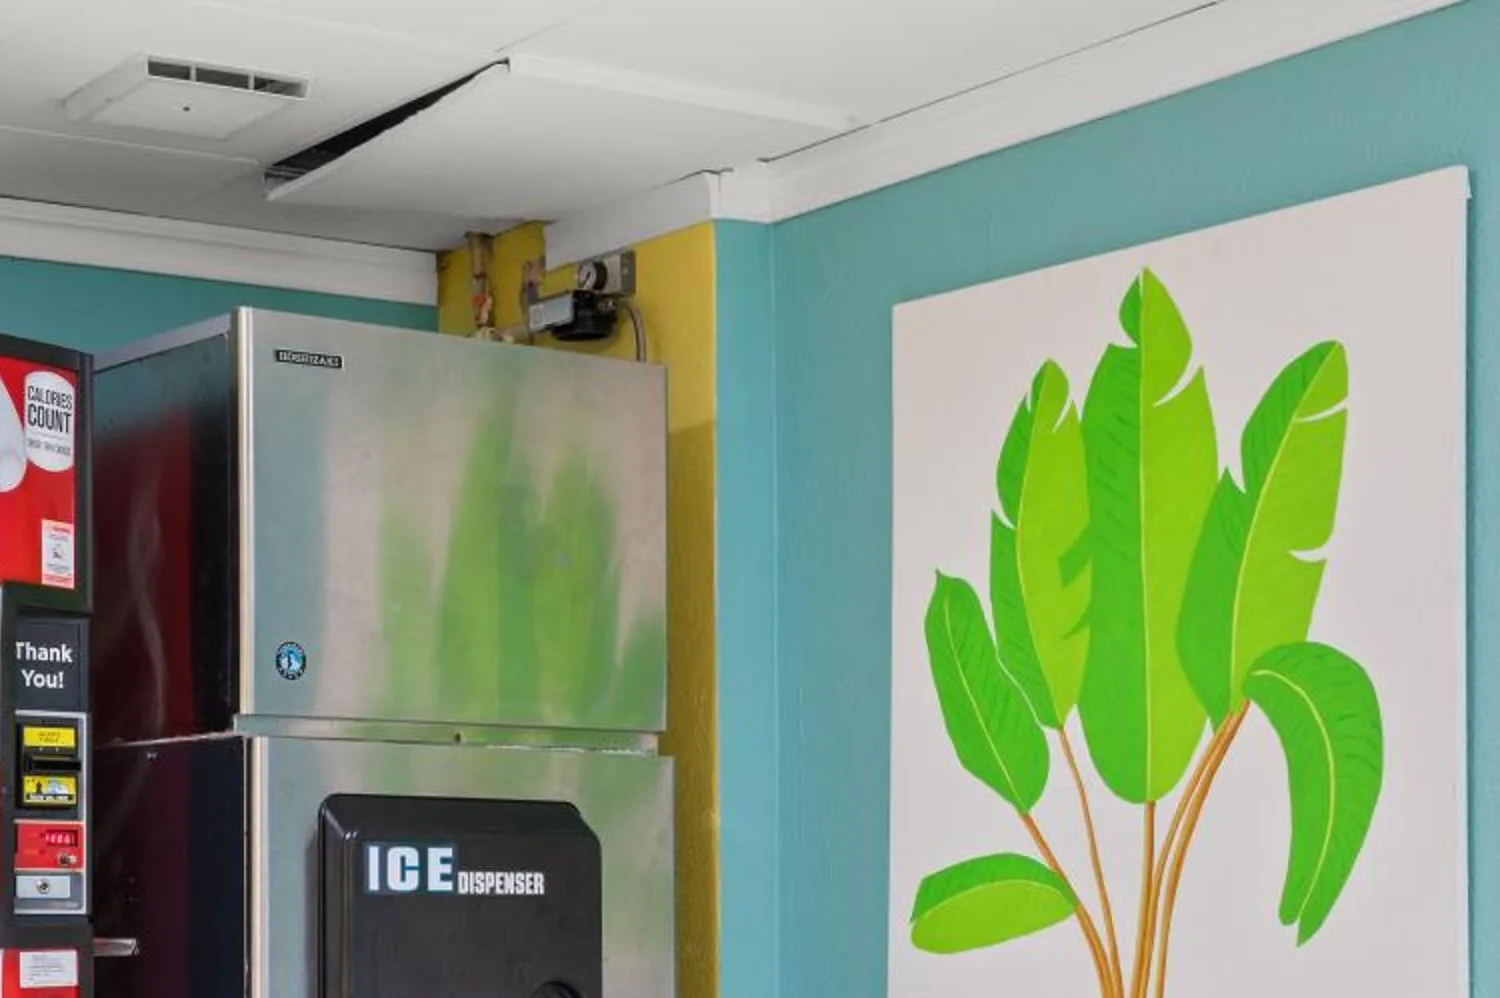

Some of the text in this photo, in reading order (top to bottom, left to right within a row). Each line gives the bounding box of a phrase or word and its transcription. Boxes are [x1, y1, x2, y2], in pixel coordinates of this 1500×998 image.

[27, 403, 73, 434] COUNT
[15, 641, 73, 663] Thank
[21, 669, 64, 689] You!
[368, 846, 545, 895] ICE DISPENSER
